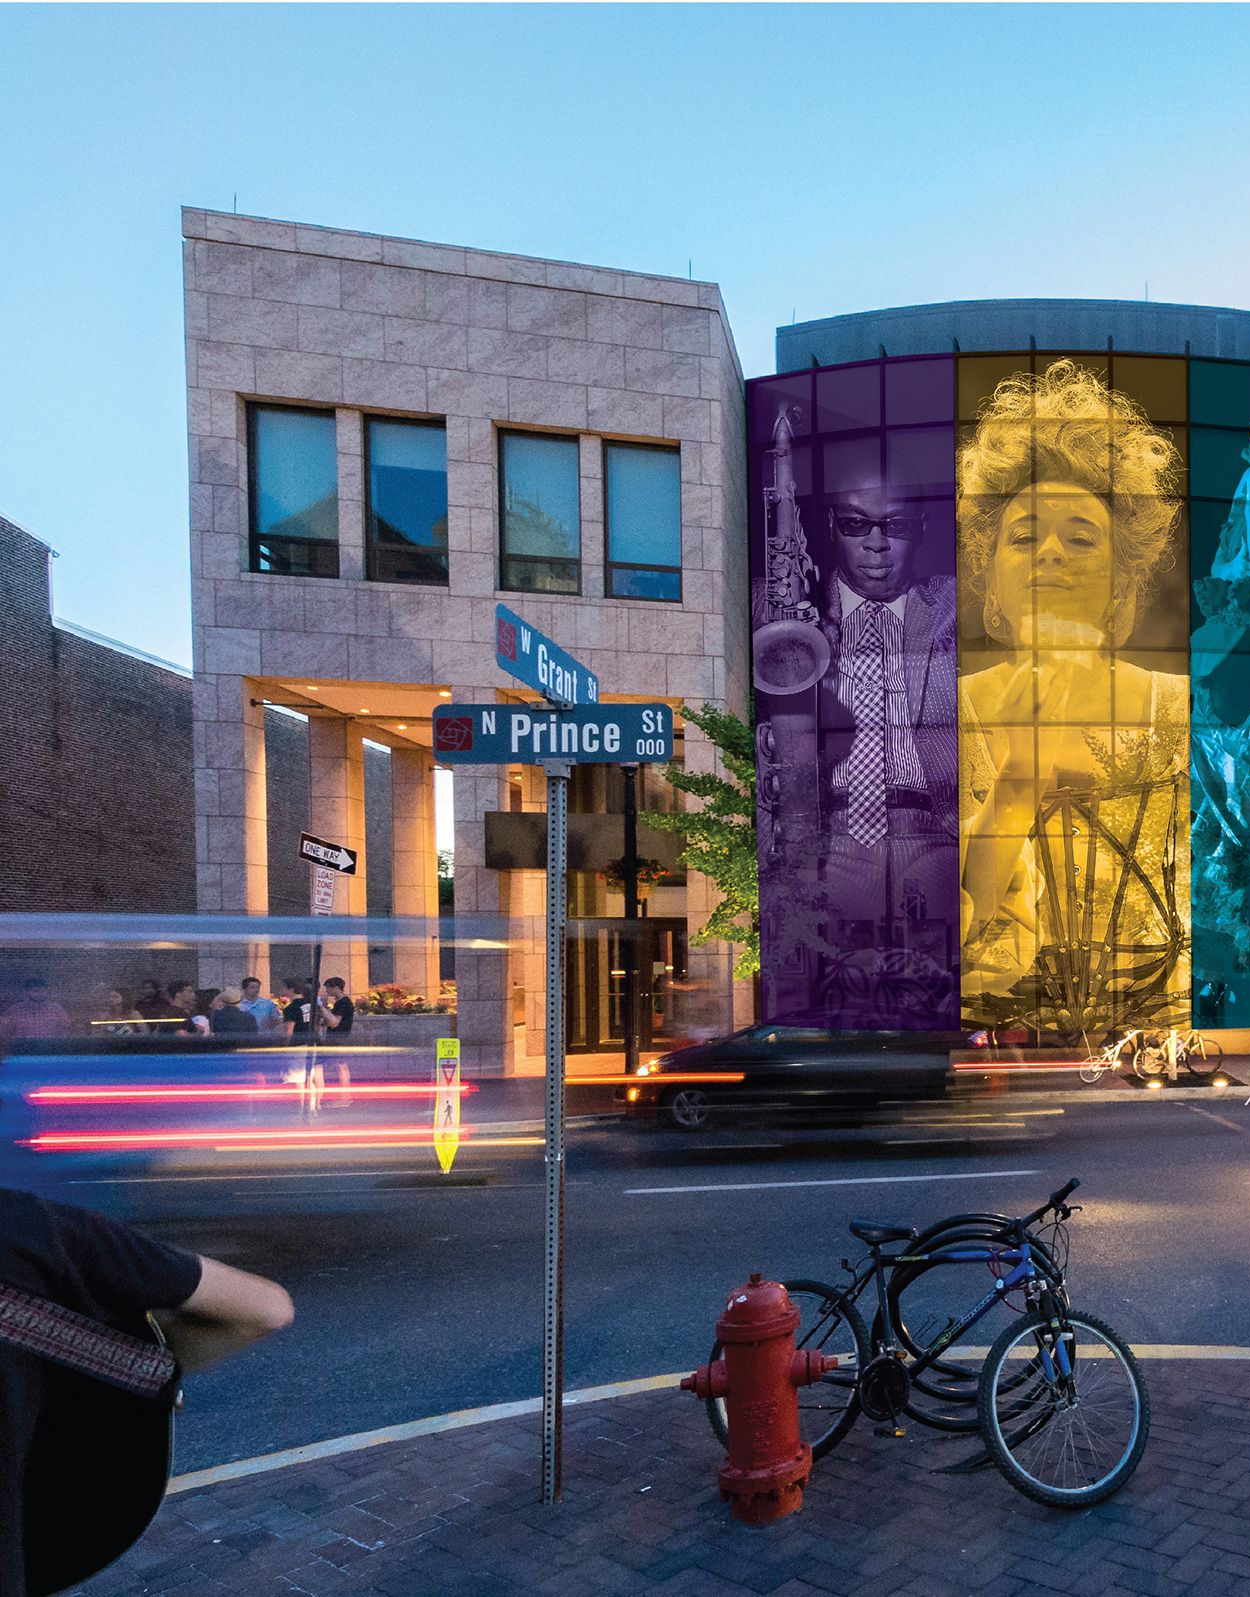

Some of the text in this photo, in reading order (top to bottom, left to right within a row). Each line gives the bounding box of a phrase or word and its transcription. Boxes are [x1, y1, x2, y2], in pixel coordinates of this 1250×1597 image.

[520, 626, 597, 705] W Grant St
[482, 709, 664, 753] N Prince St
[636, 739, 665, 755] 000
[305, 842, 340, 861] ONE WAY
[317, 870, 334, 881] LOAD
[316, 879, 333, 890] ZONE
